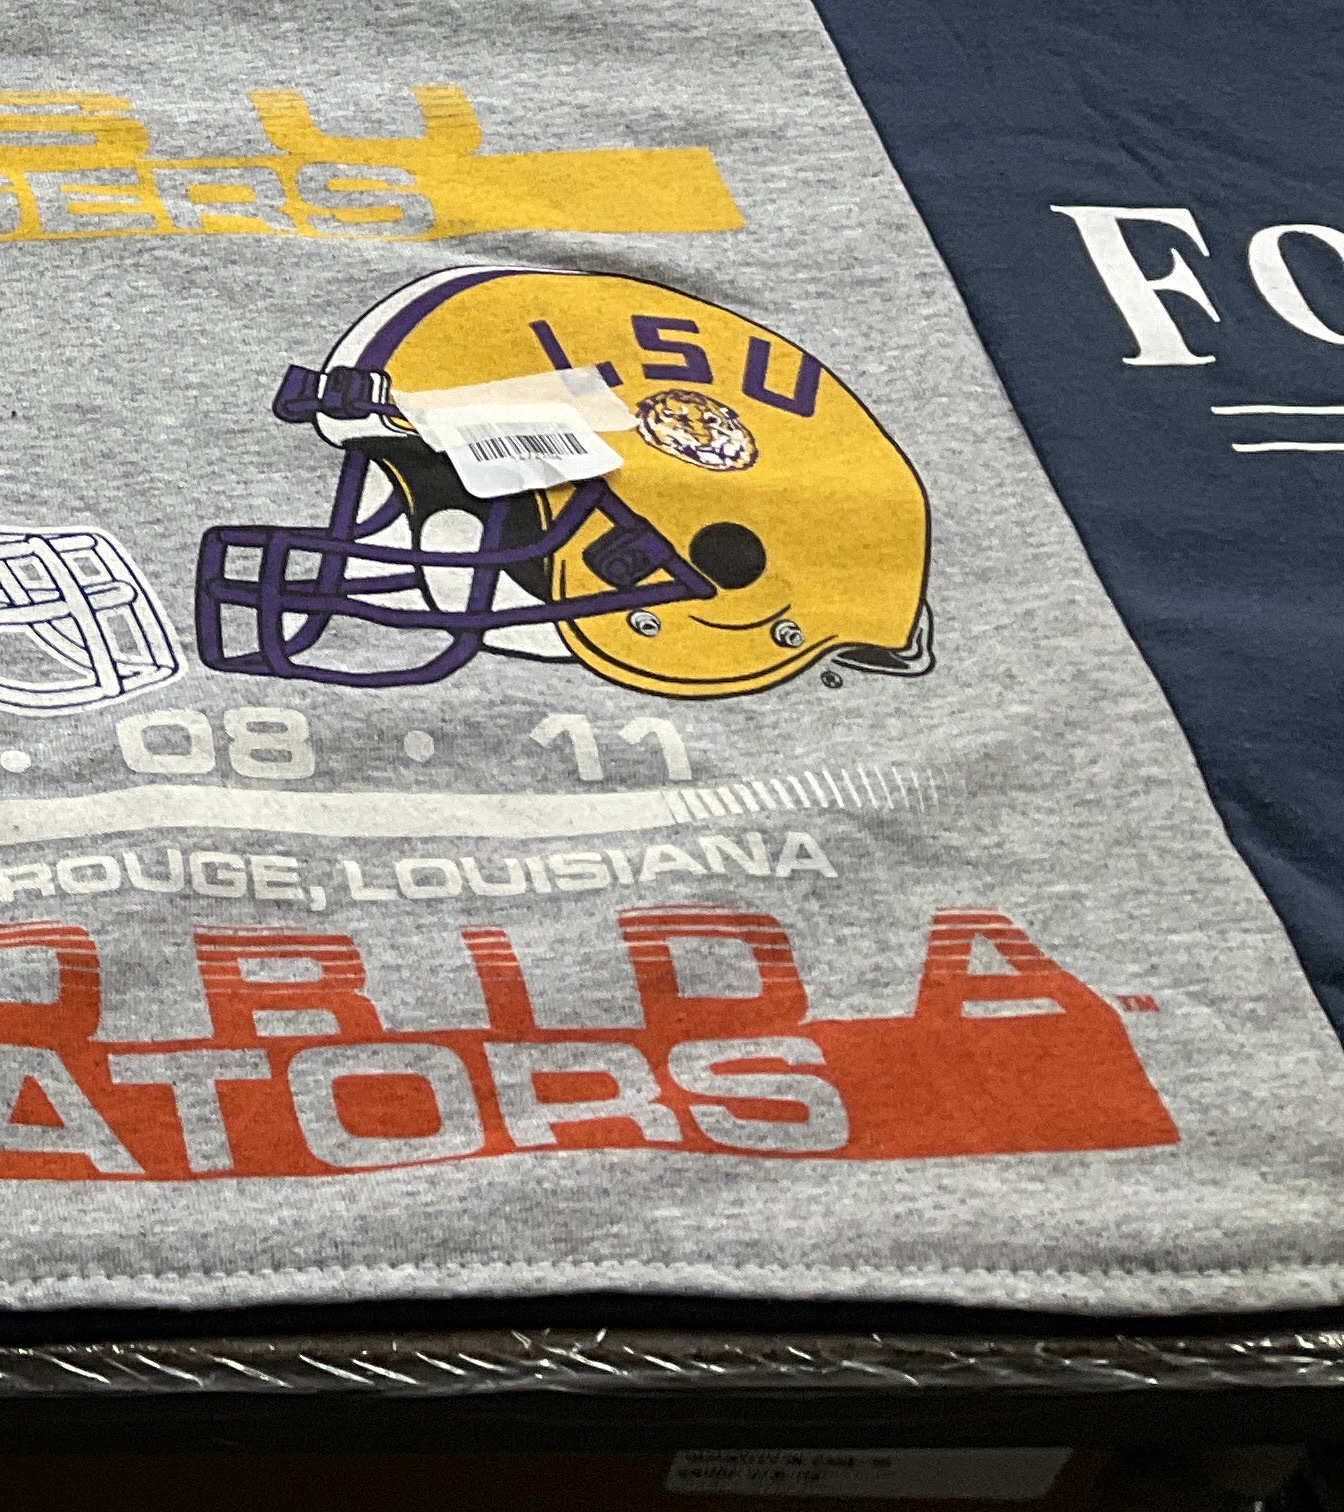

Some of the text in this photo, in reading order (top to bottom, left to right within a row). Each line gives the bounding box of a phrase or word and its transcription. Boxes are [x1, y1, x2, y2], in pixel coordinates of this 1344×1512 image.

[529, 314, 824, 418] LSU
[118, 704, 313, 781] 08
[532, 708, 696, 782] 11
[345, 830, 840, 906] LOUISIANA
